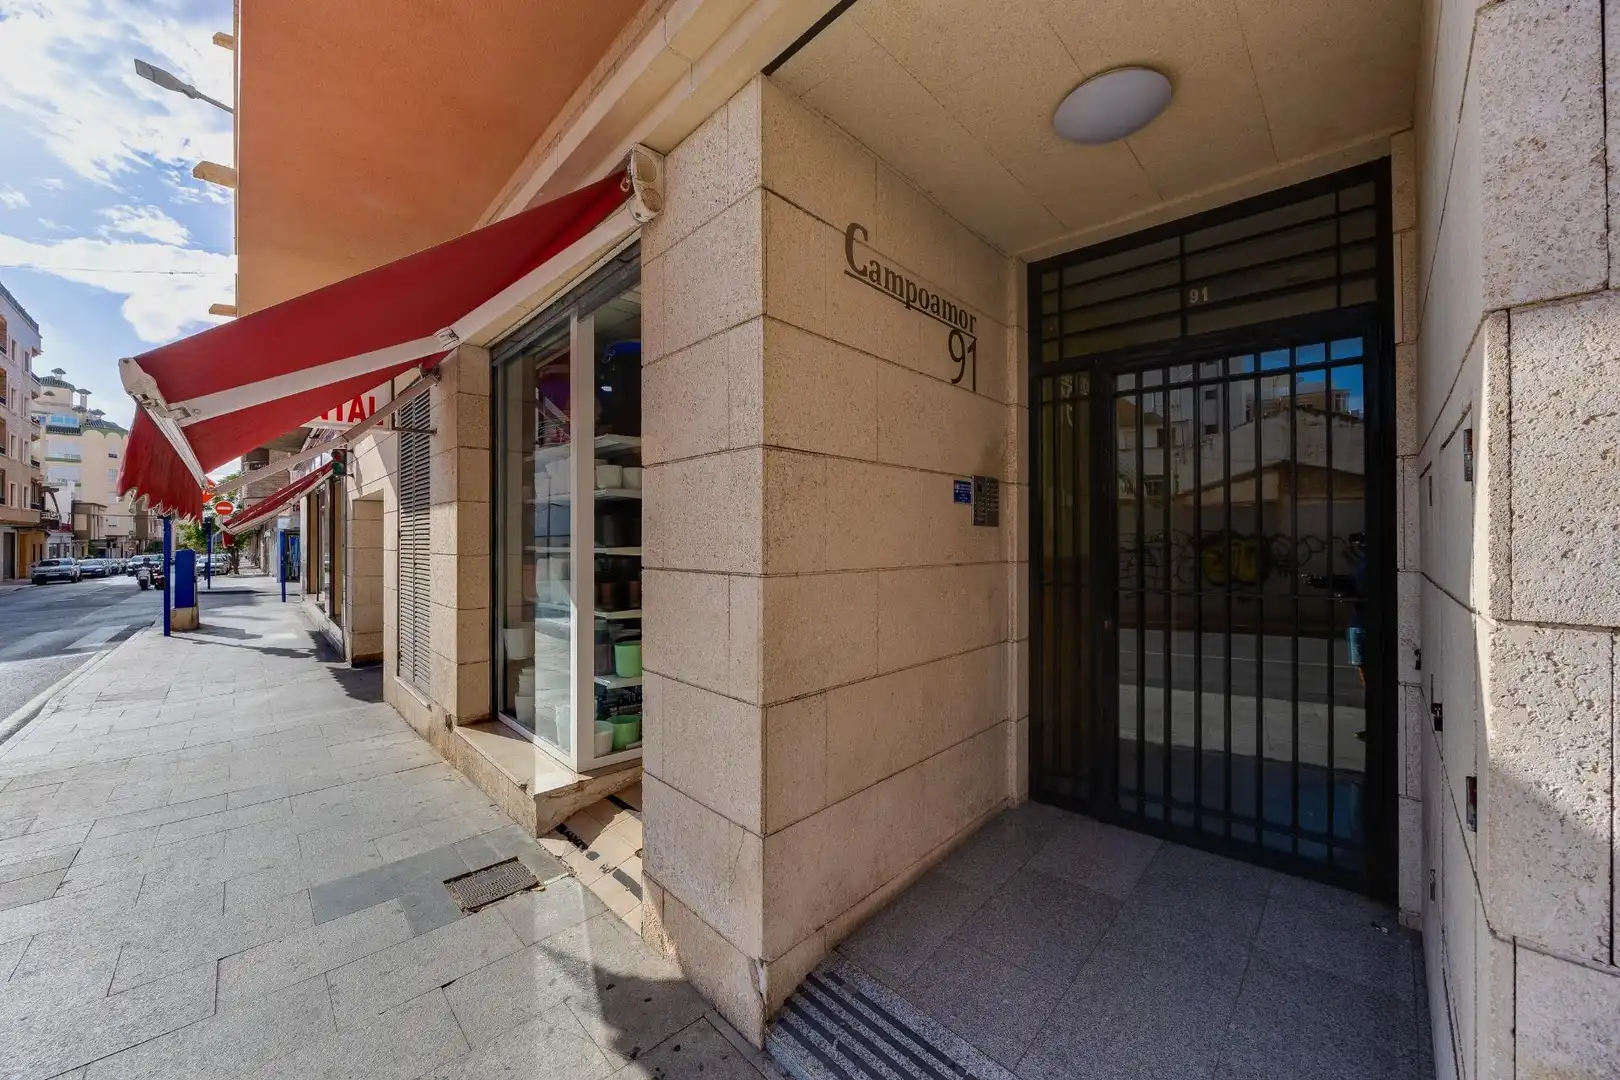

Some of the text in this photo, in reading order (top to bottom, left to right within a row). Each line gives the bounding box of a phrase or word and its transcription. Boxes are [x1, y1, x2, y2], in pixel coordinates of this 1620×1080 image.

[844, 222, 977, 334] Campoamor
[1189, 286, 1208, 304] 91
[948, 328, 977, 391] 91
